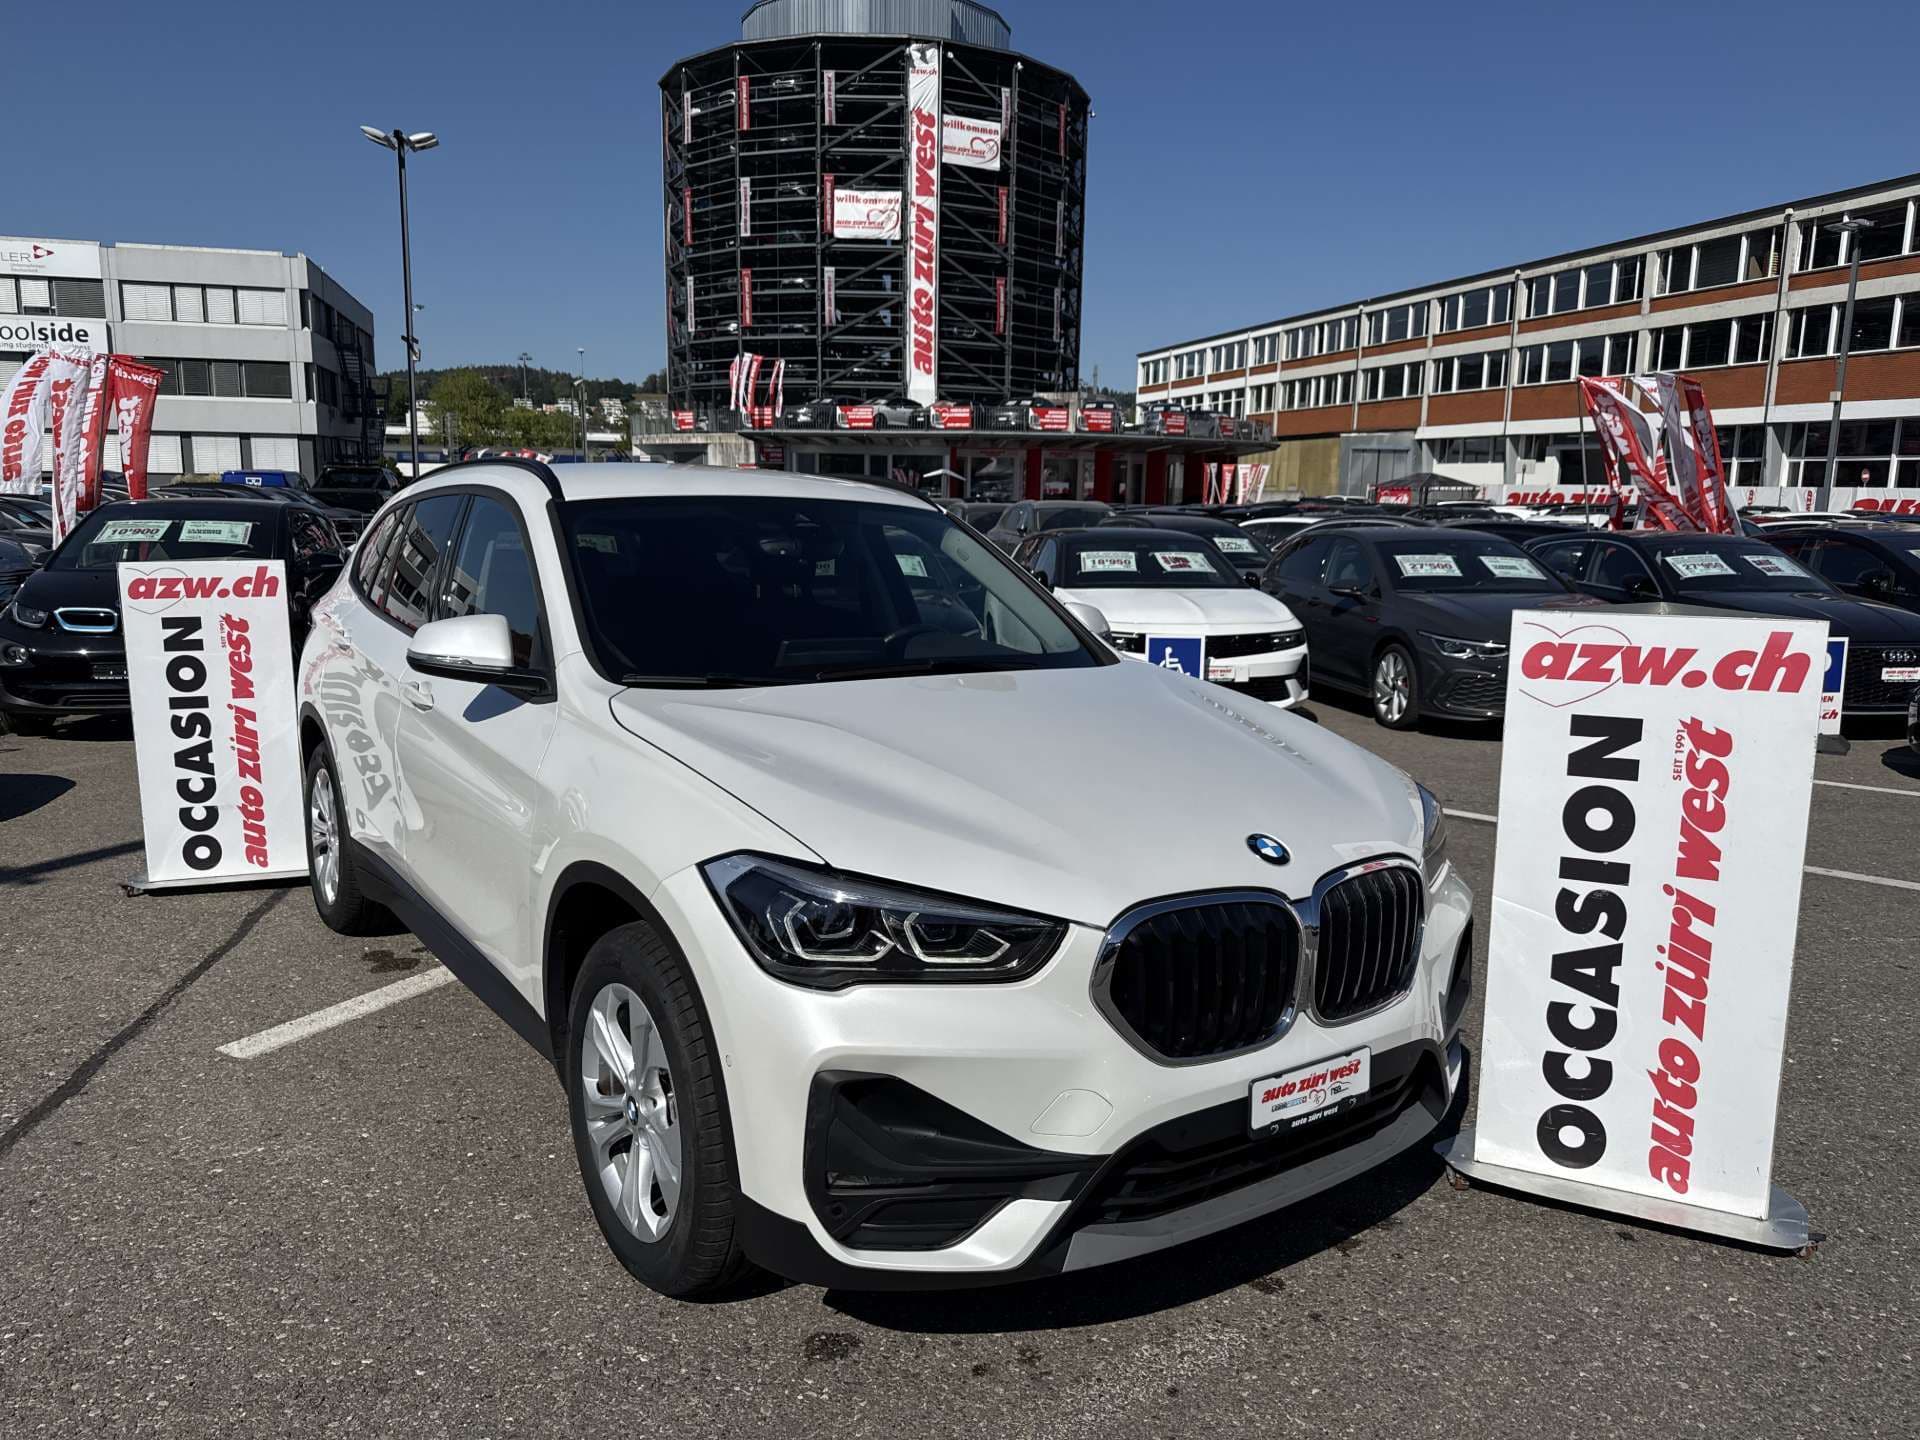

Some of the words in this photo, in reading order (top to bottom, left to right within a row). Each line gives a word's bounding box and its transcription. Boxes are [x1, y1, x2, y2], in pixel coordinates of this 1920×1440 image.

[913, 105, 936, 197] west
[943, 119, 999, 135] willkommen
[910, 200, 936, 284] züri
[911, 287, 935, 375] auto
[127, 566, 278, 599] azw.ch
[219, 613, 255, 699] west
[1521, 631, 1811, 694] azw.ch
[161, 616, 222, 871] OCCASION
[227, 703, 262, 784] züri
[1672, 757, 1683, 781] SEIT
[1675, 728, 1685, 754] 1991
[239, 785, 269, 869] auto
[1675, 716, 1734, 882] west
[1536, 713, 1644, 1169] OCCASION
[1655, 883, 1717, 1042] züri
[1261, 1080, 1297, 1104] auto
[1297, 1067, 1330, 1092] züri
[1329, 1058, 1362, 1082] west
[1291, 1114, 1308, 1128] auto
[1308, 1110, 1323, 1123] züri
[1323, 1106, 1339, 1117] west
[1647, 1038, 1701, 1195] auto
